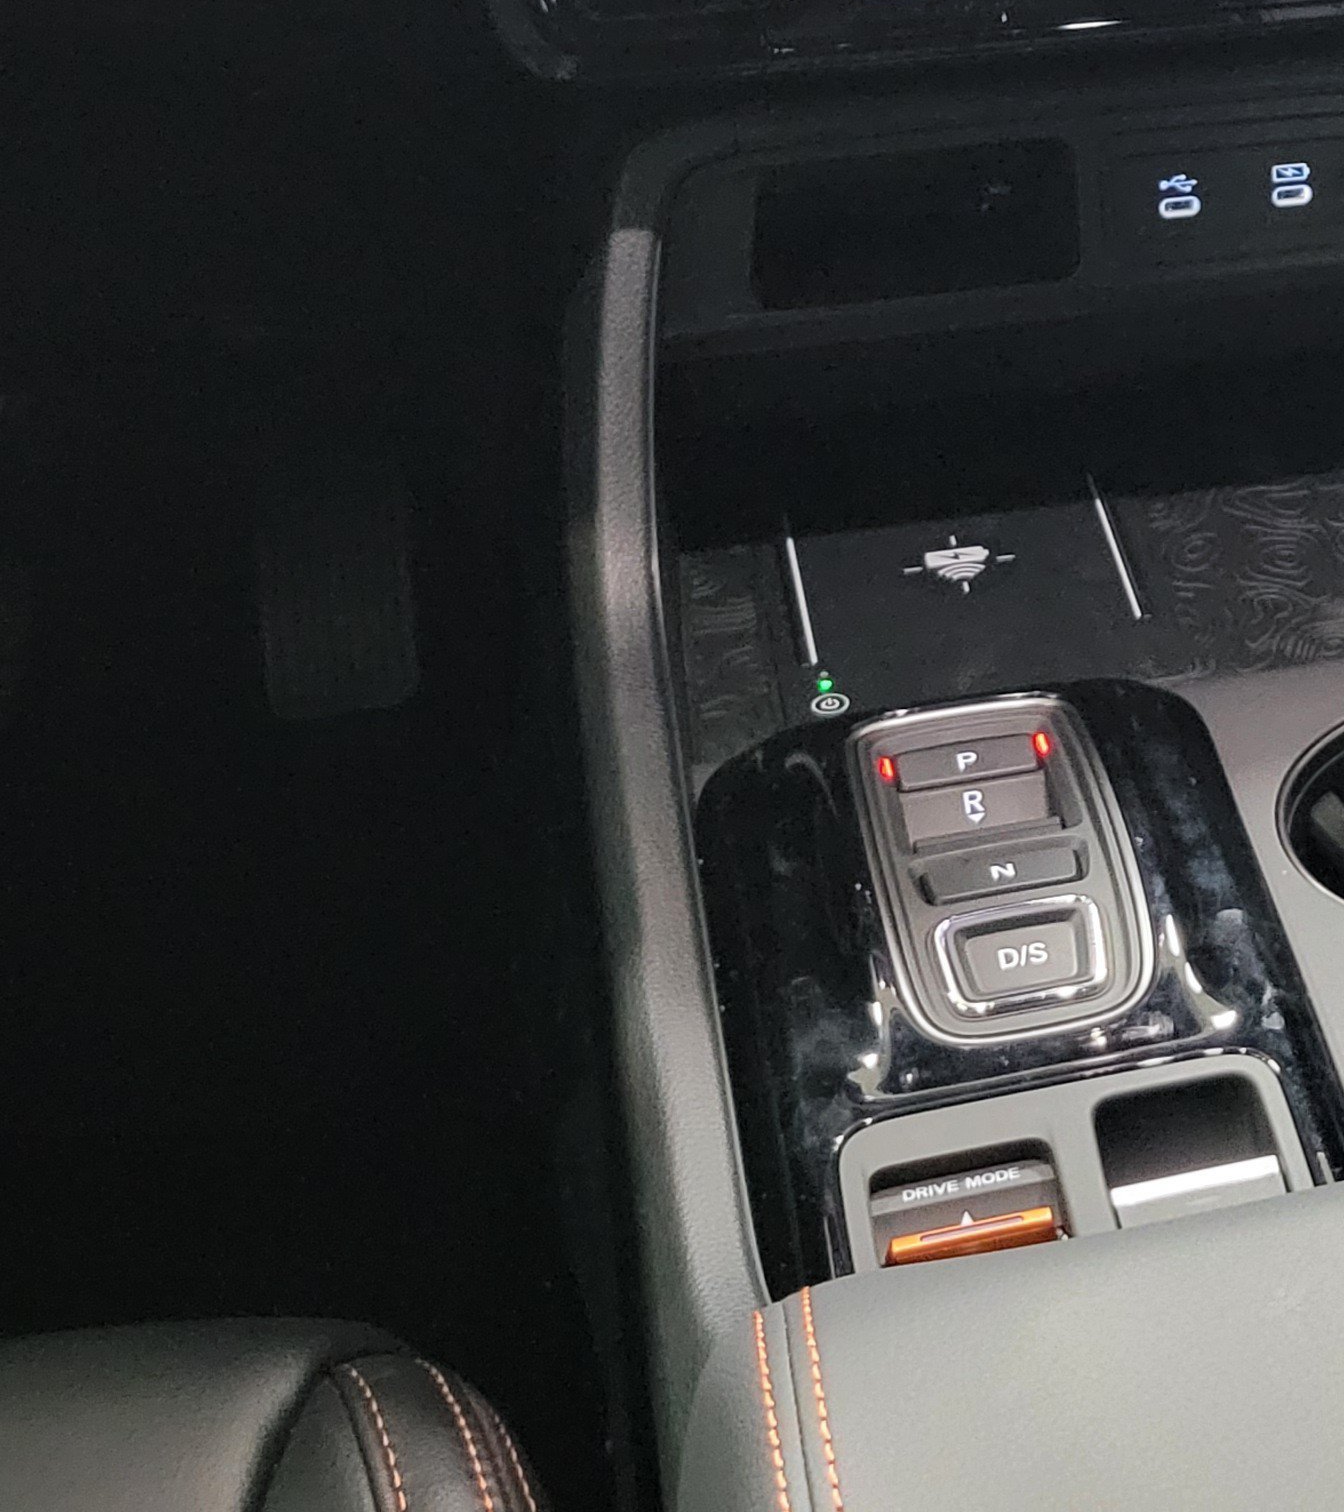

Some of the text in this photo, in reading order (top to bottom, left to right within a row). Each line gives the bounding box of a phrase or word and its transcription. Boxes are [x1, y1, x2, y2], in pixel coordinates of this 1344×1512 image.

[957, 751, 978, 770] P
[963, 790, 985, 814] R
[990, 862, 1017, 880] N
[997, 943, 1049, 971] D/S
[902, 1167, 1020, 1202] DRIVE MODE
